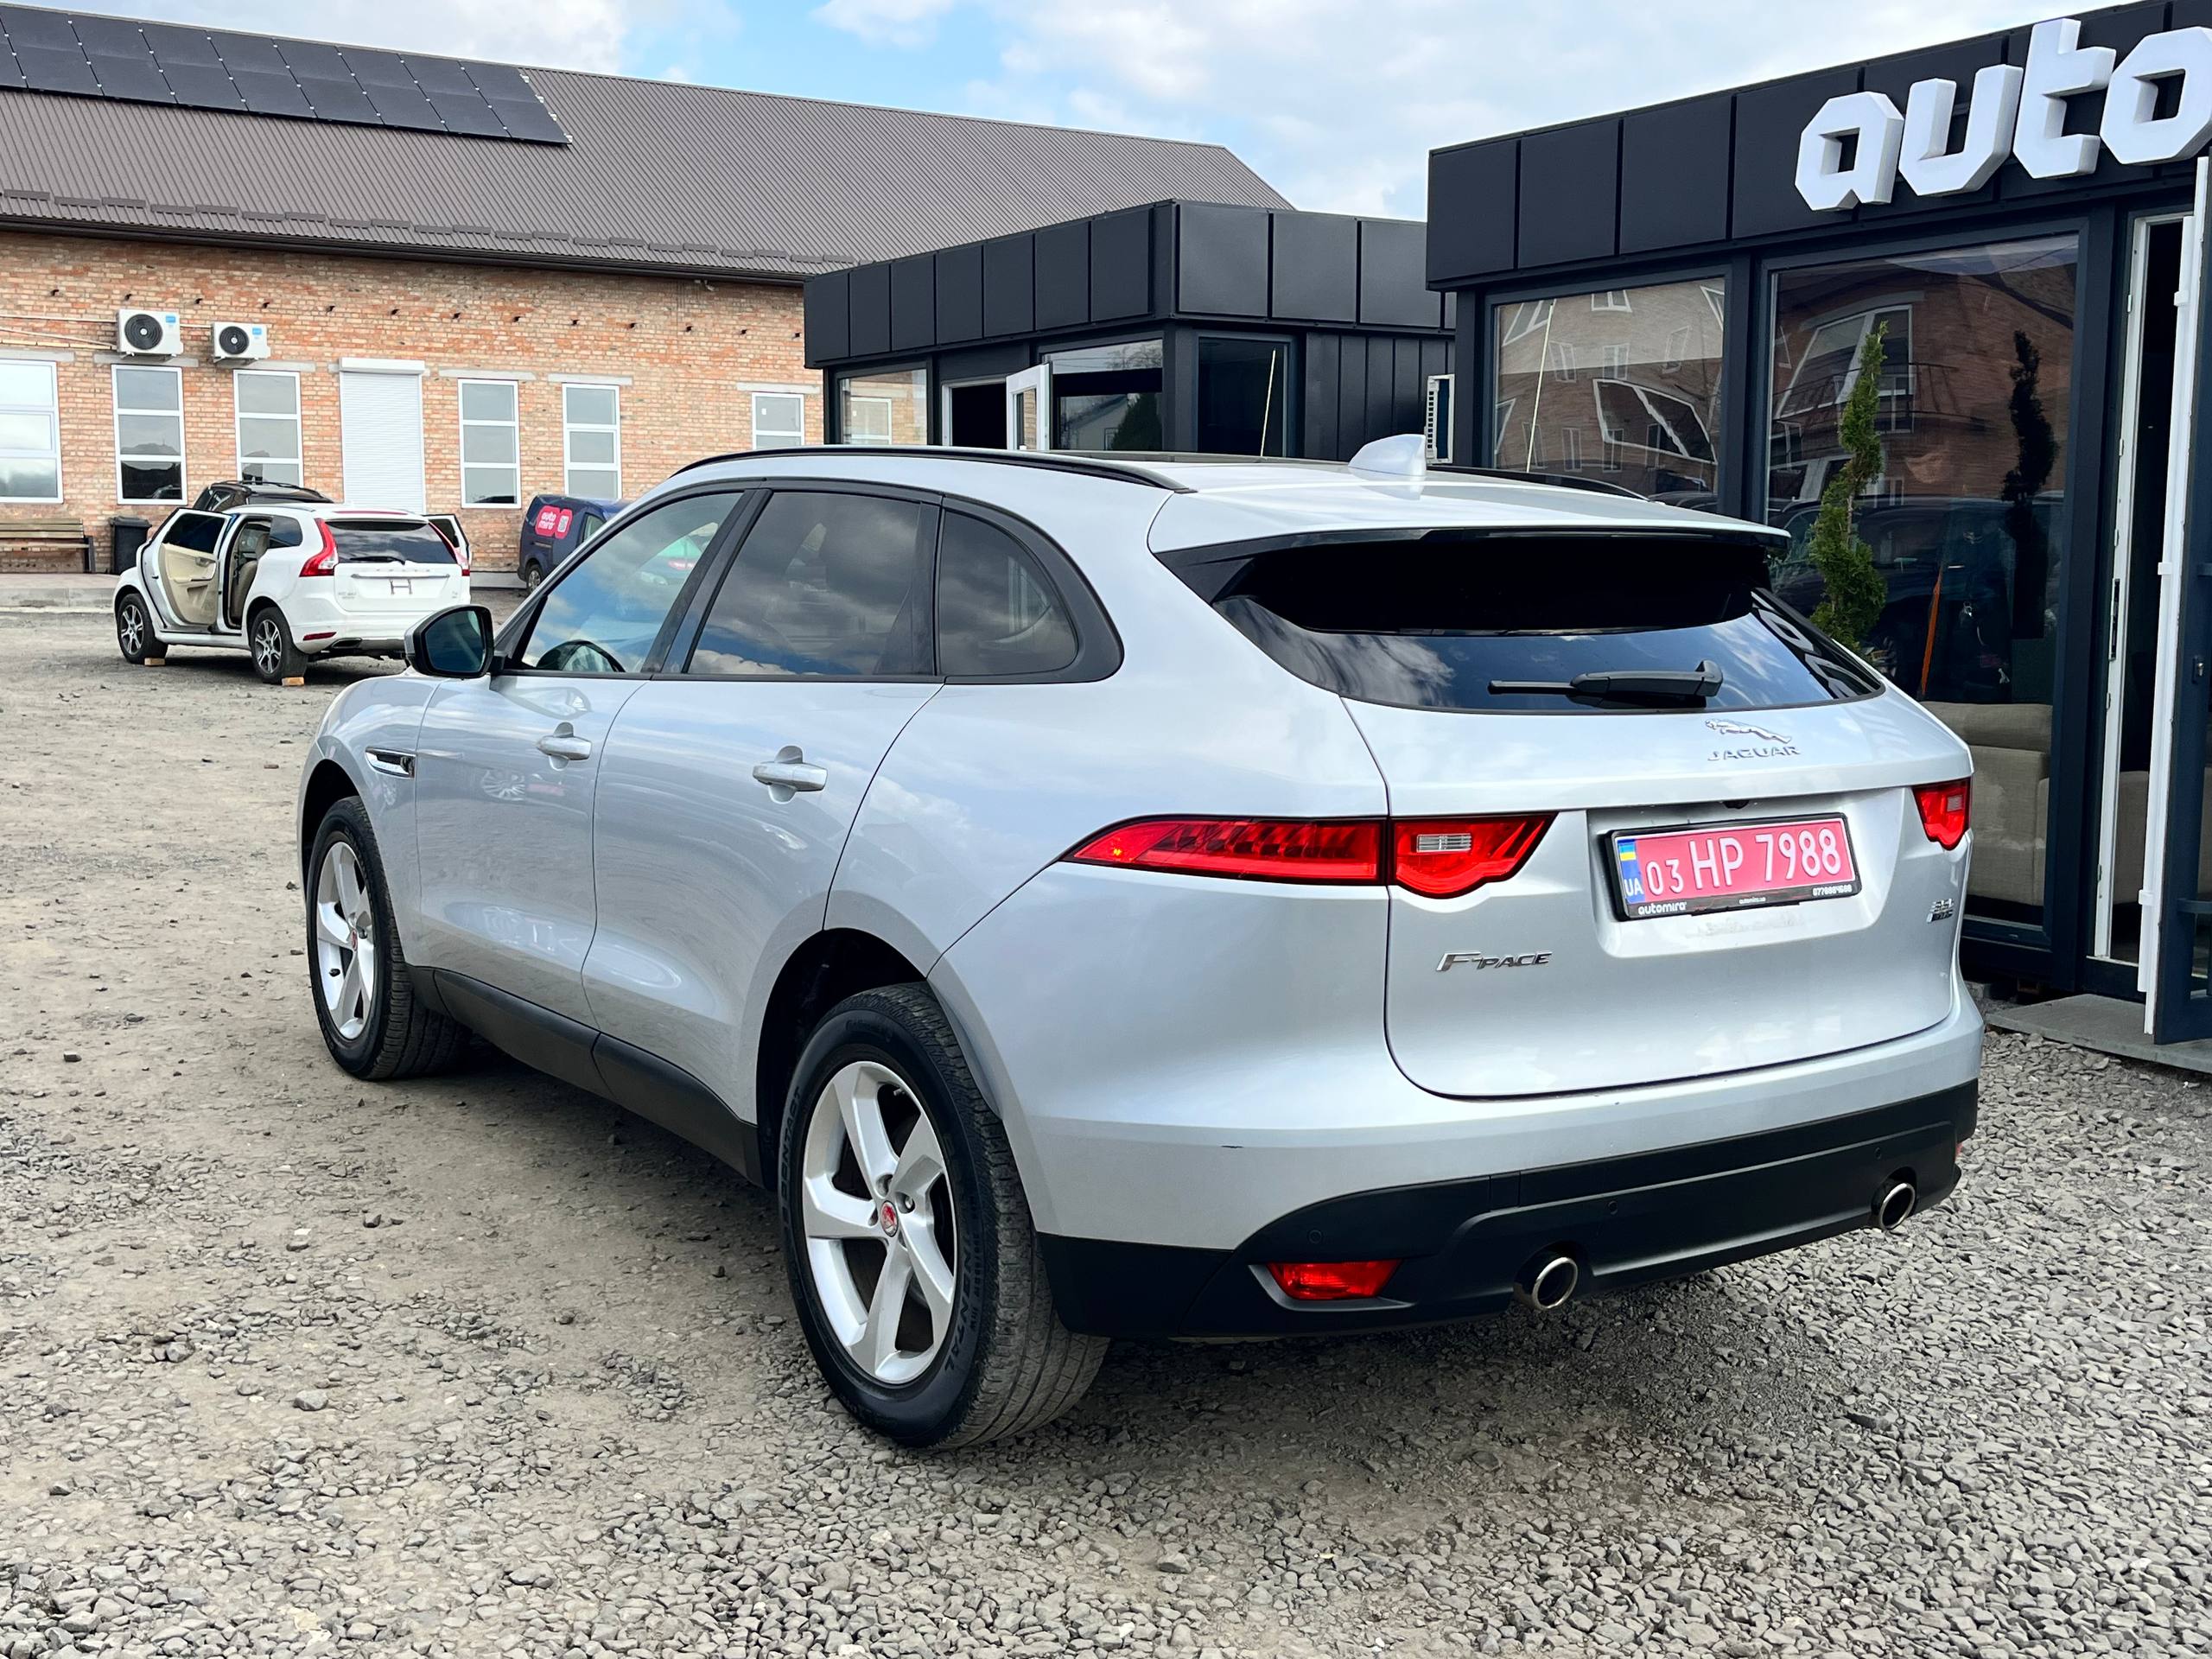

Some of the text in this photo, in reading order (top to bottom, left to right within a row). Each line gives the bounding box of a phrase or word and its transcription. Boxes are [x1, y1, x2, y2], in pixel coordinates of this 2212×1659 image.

[1795, 18, 2212, 212] auto
[1707, 746, 1801, 761] JAGUAR
[1624, 827, 1841, 897] UA 03 HP 7988
[1637, 901, 1686, 916] automira
